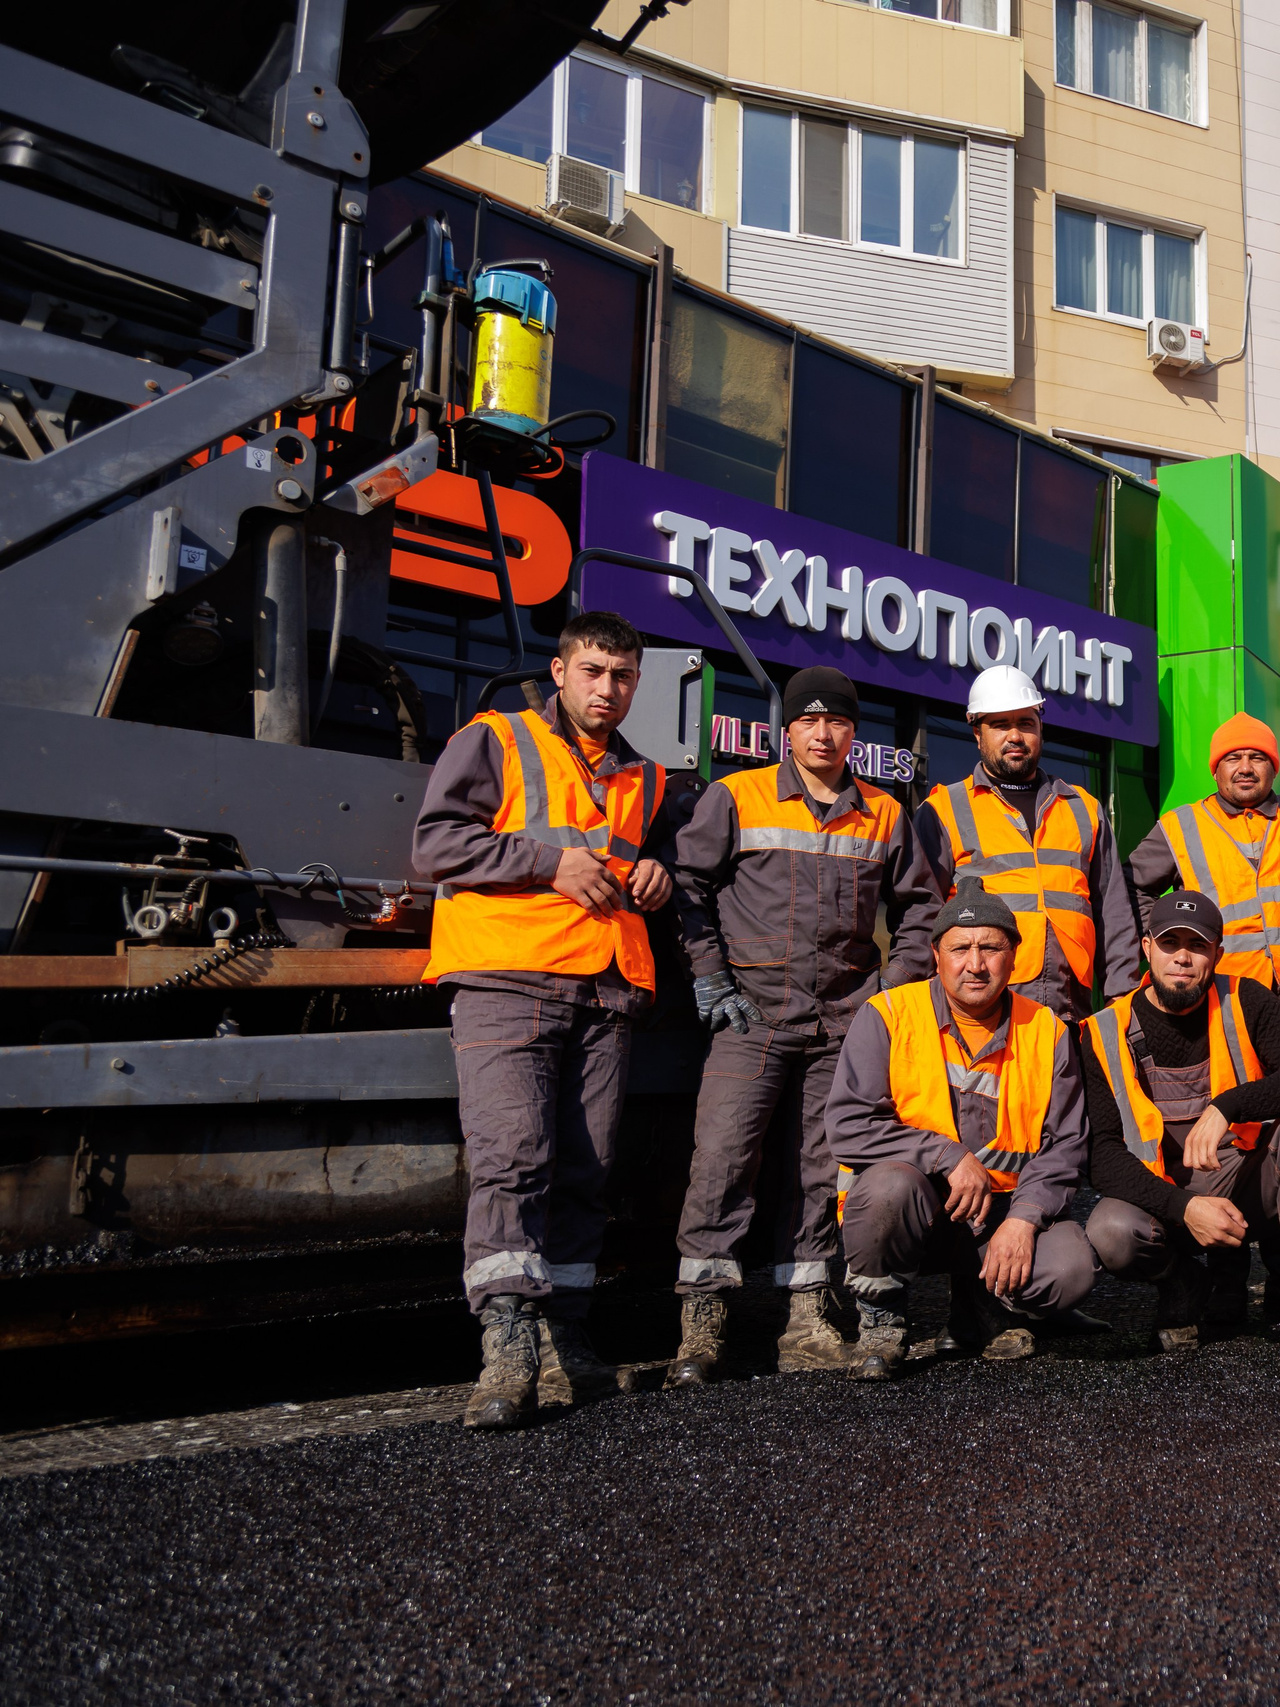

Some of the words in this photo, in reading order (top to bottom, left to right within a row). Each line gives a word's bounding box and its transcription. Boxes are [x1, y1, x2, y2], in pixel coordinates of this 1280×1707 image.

[1191, 330, 1201, 338] TCL
[653, 510, 1132, 706] ТЕХНОПОИНТ
[711, 714, 915, 783] ILDRIES
